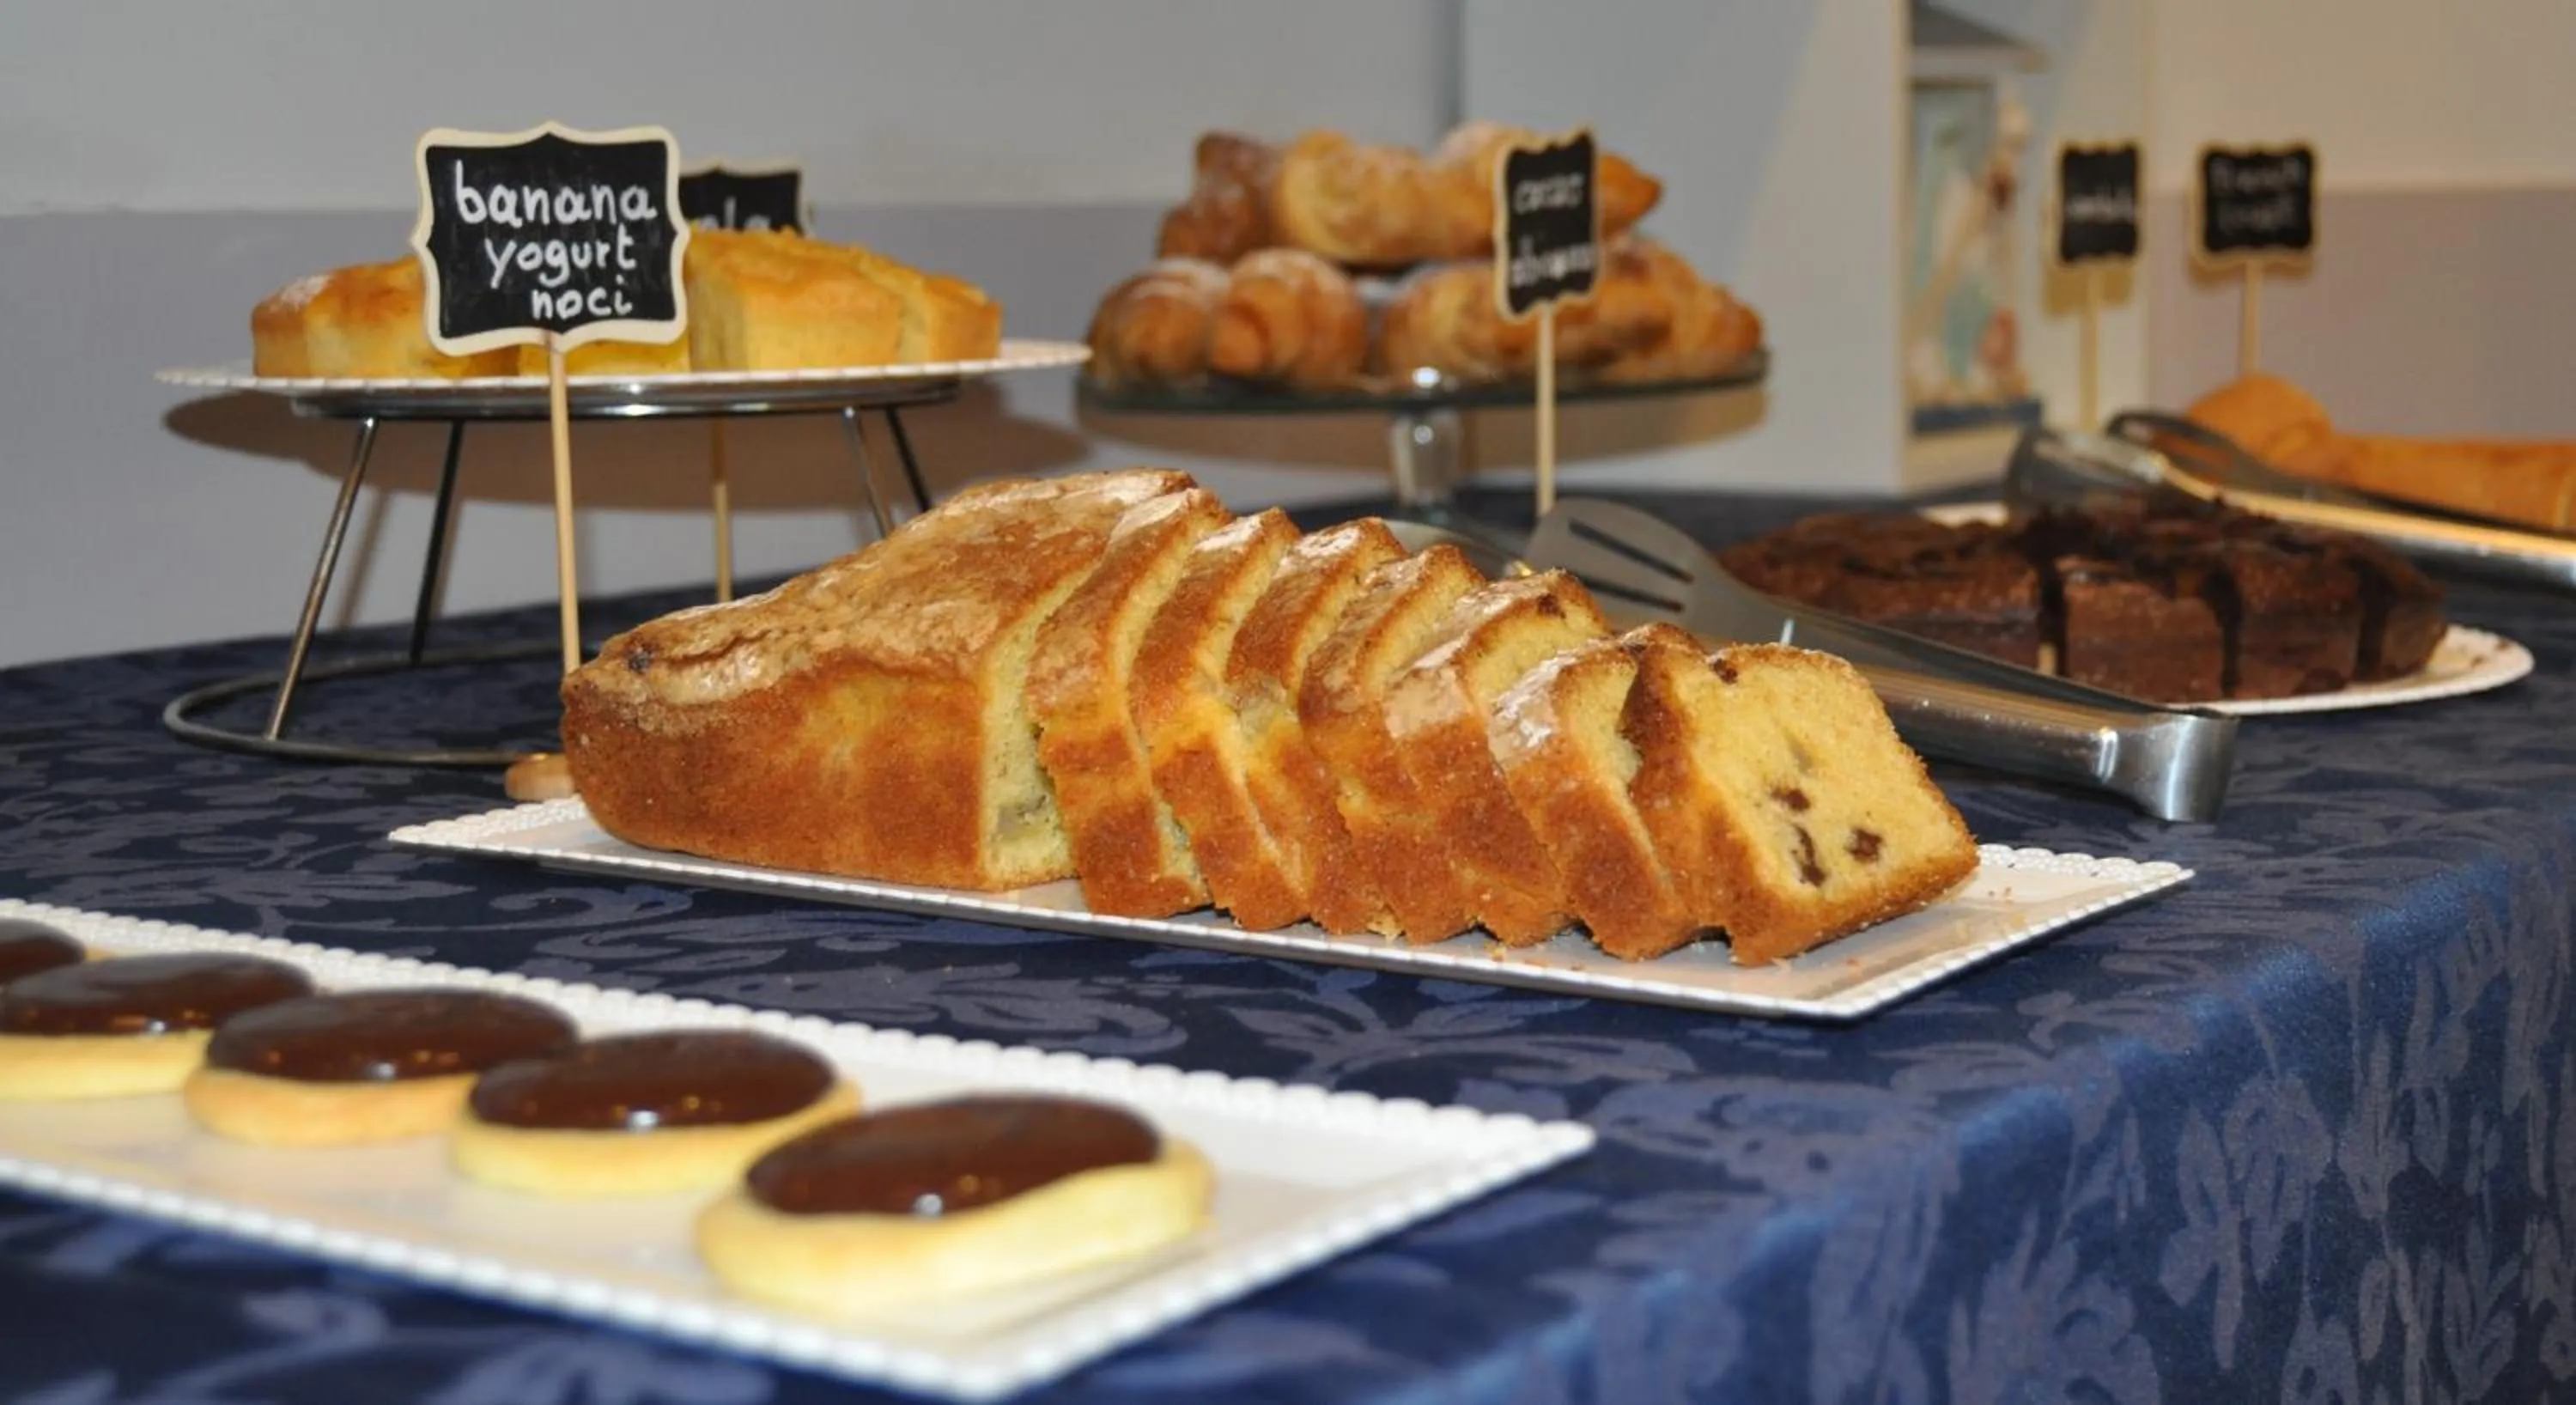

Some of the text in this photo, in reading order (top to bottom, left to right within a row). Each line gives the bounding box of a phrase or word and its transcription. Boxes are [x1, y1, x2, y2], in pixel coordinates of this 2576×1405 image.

[454, 160, 657, 228] banana
[484, 224, 636, 289] yogurt
[532, 275, 633, 319] noci
